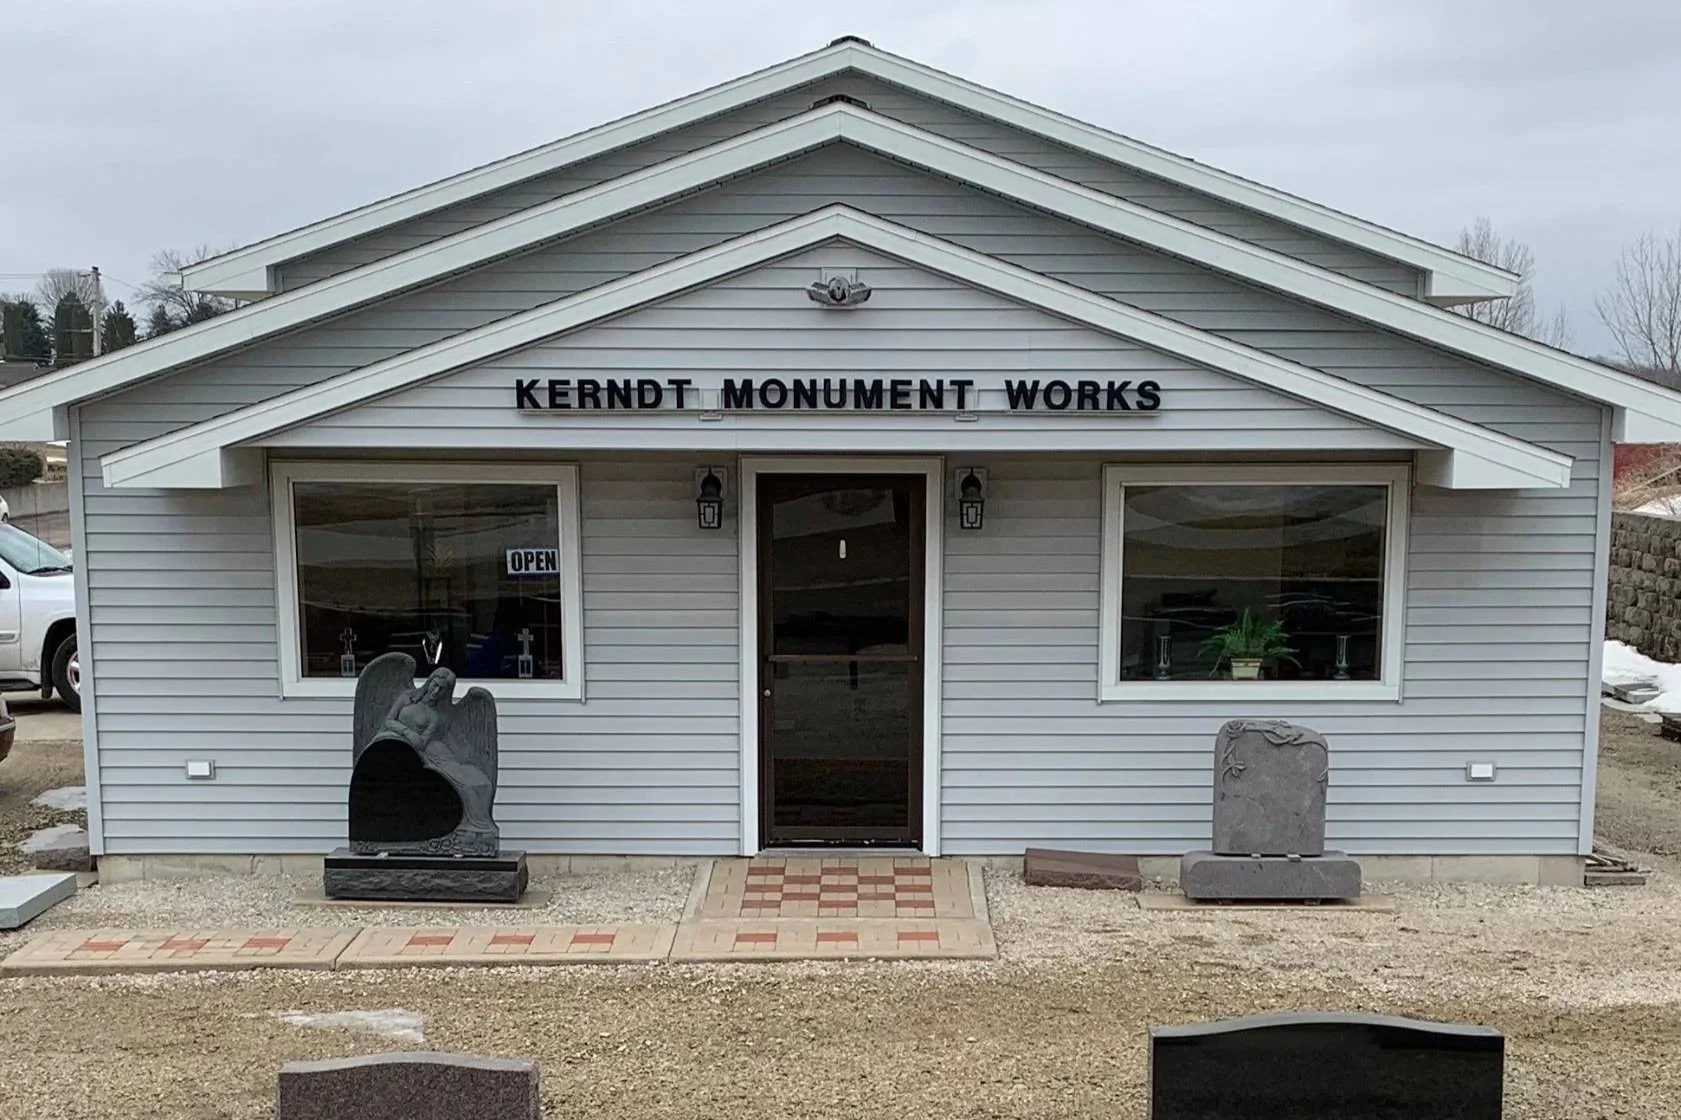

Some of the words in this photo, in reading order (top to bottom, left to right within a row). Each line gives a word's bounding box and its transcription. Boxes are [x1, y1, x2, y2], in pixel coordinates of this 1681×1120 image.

[515, 378, 692, 409] KERNDT
[723, 378, 974, 410] MONUMENT
[1005, 379, 1161, 411] WORKS
[511, 551, 557, 572] OPEN
